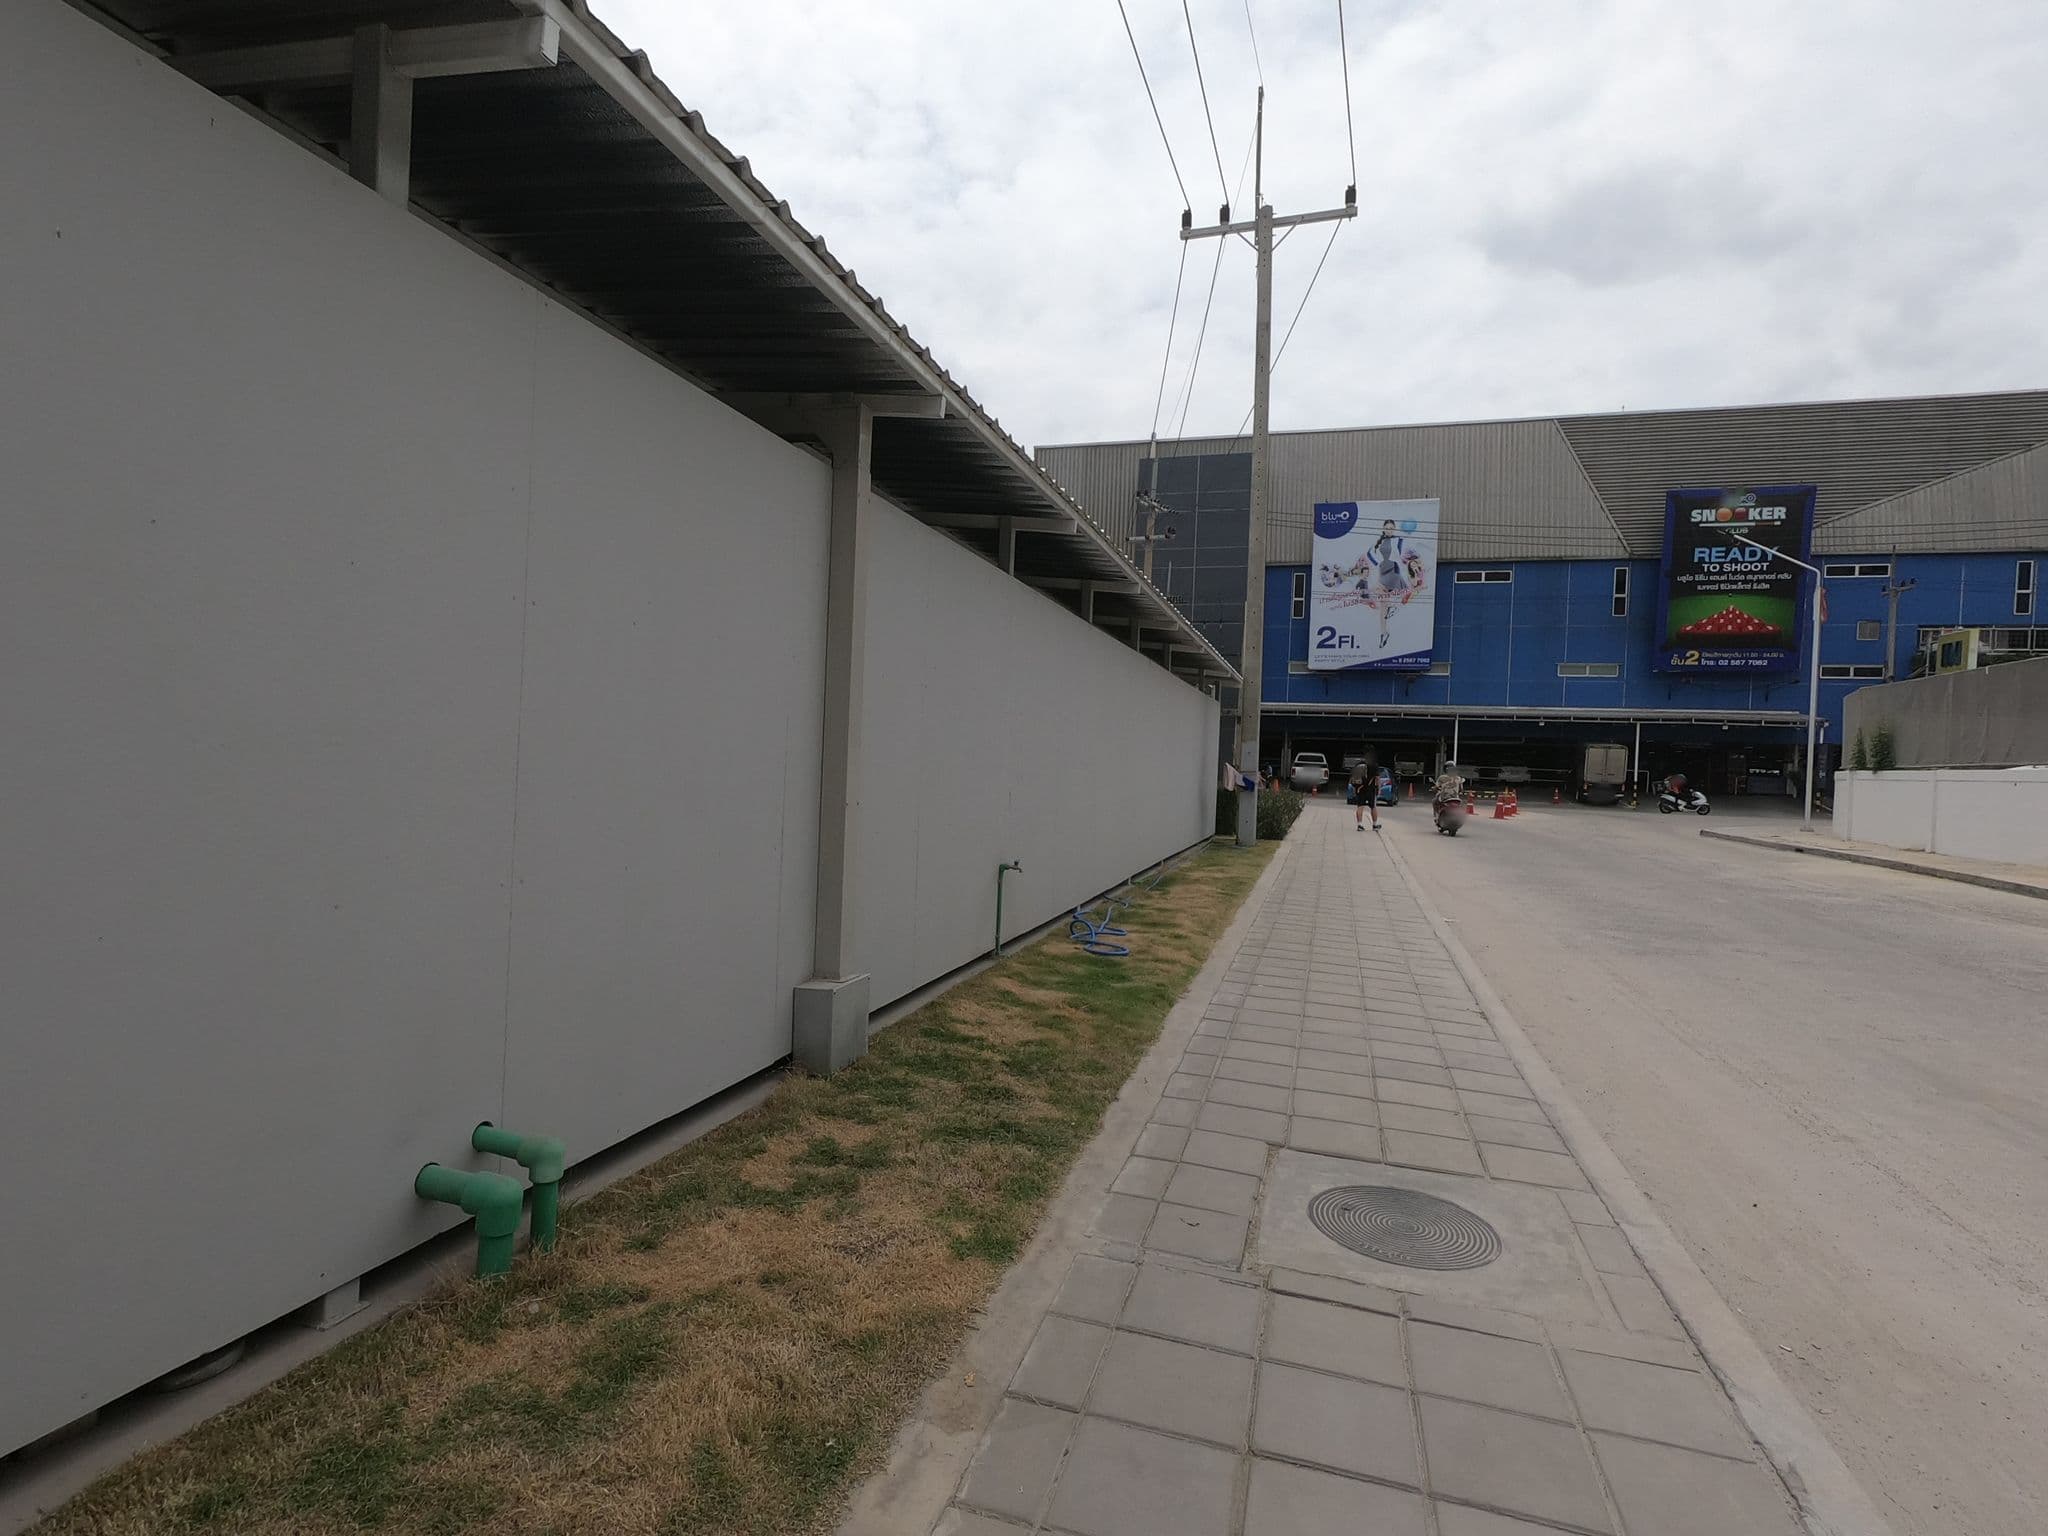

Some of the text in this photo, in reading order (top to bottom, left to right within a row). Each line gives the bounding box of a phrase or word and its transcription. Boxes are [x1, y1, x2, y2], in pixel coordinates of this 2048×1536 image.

[1690, 506, 1787, 523] SNOOKER
[1693, 546, 1780, 563] READY
[1702, 562, 1770, 572] TO SHOOT
[1684, 650, 1700, 666] 2
